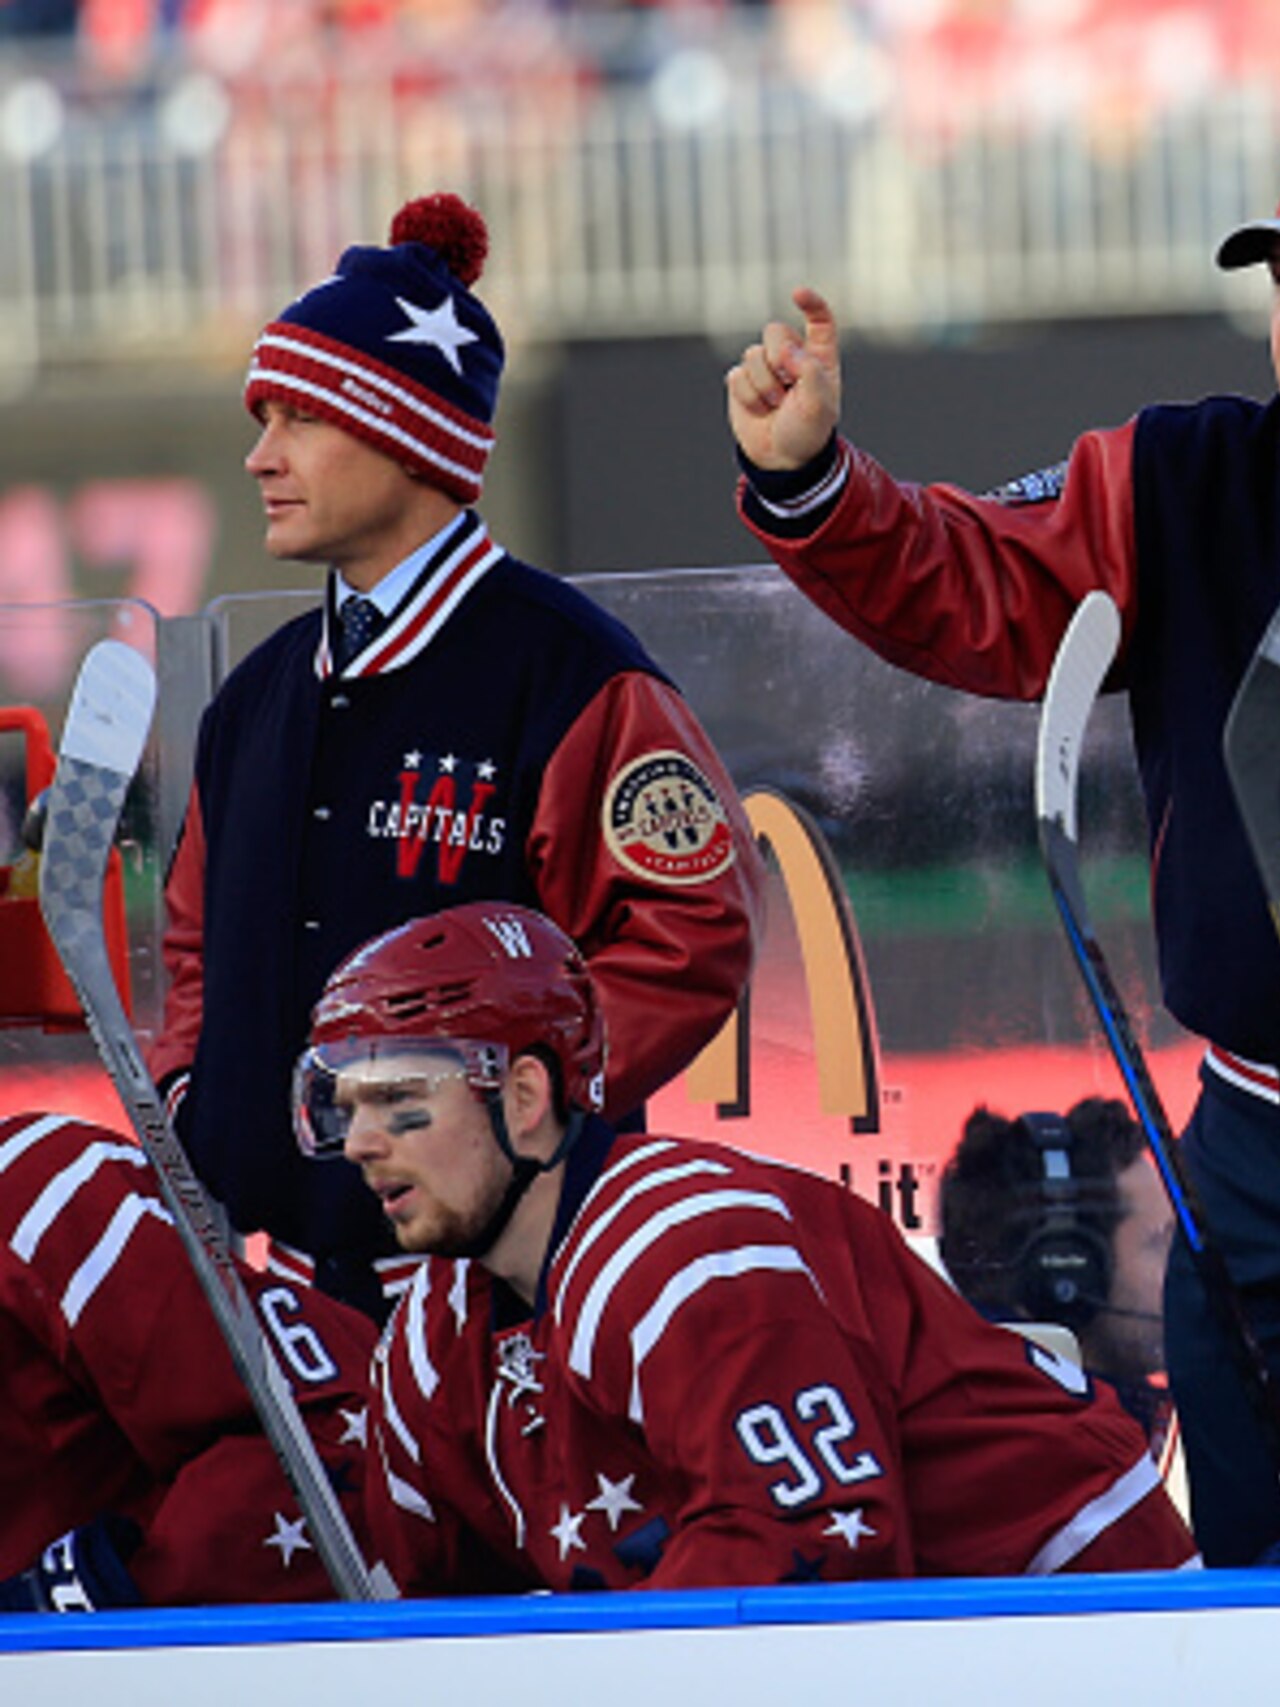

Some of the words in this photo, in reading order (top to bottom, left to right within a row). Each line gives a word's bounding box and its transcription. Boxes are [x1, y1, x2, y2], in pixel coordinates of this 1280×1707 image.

[367, 800, 507, 855] CAPITALS
[259, 1286, 340, 1382] 6
[733, 1381, 886, 1510] 92
